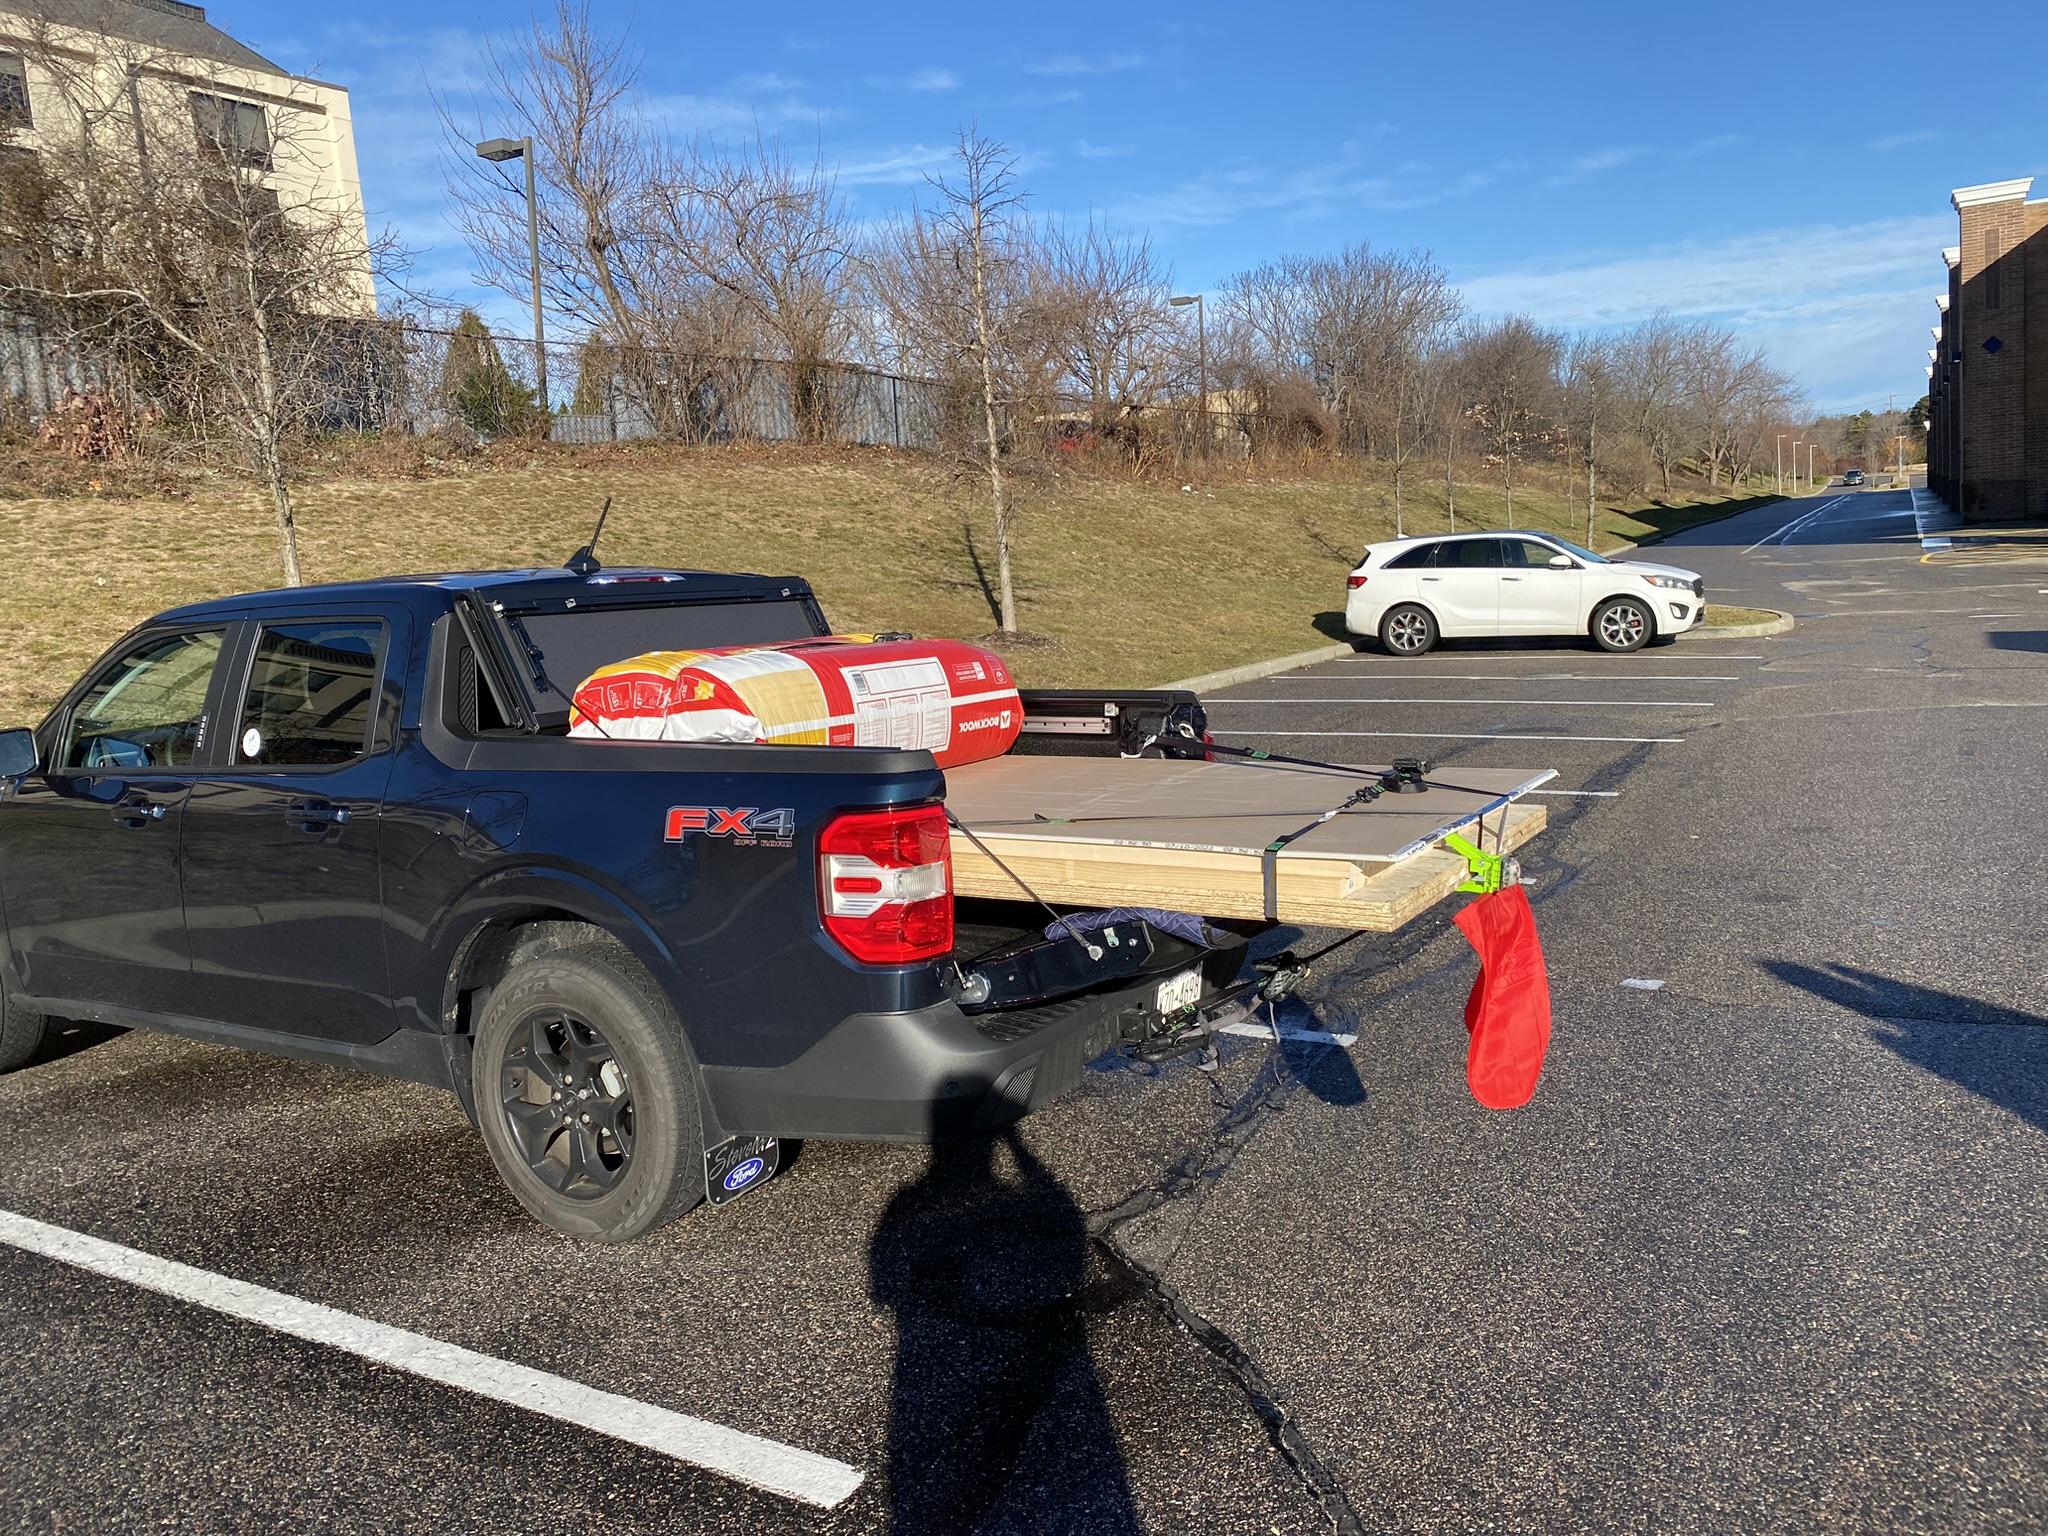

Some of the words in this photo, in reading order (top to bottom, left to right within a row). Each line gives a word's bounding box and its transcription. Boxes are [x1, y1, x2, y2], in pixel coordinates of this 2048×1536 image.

[959, 716, 1000, 732] ROCKWOOL
[664, 806, 795, 843] FX4
[730, 1162, 758, 1187] Ford
